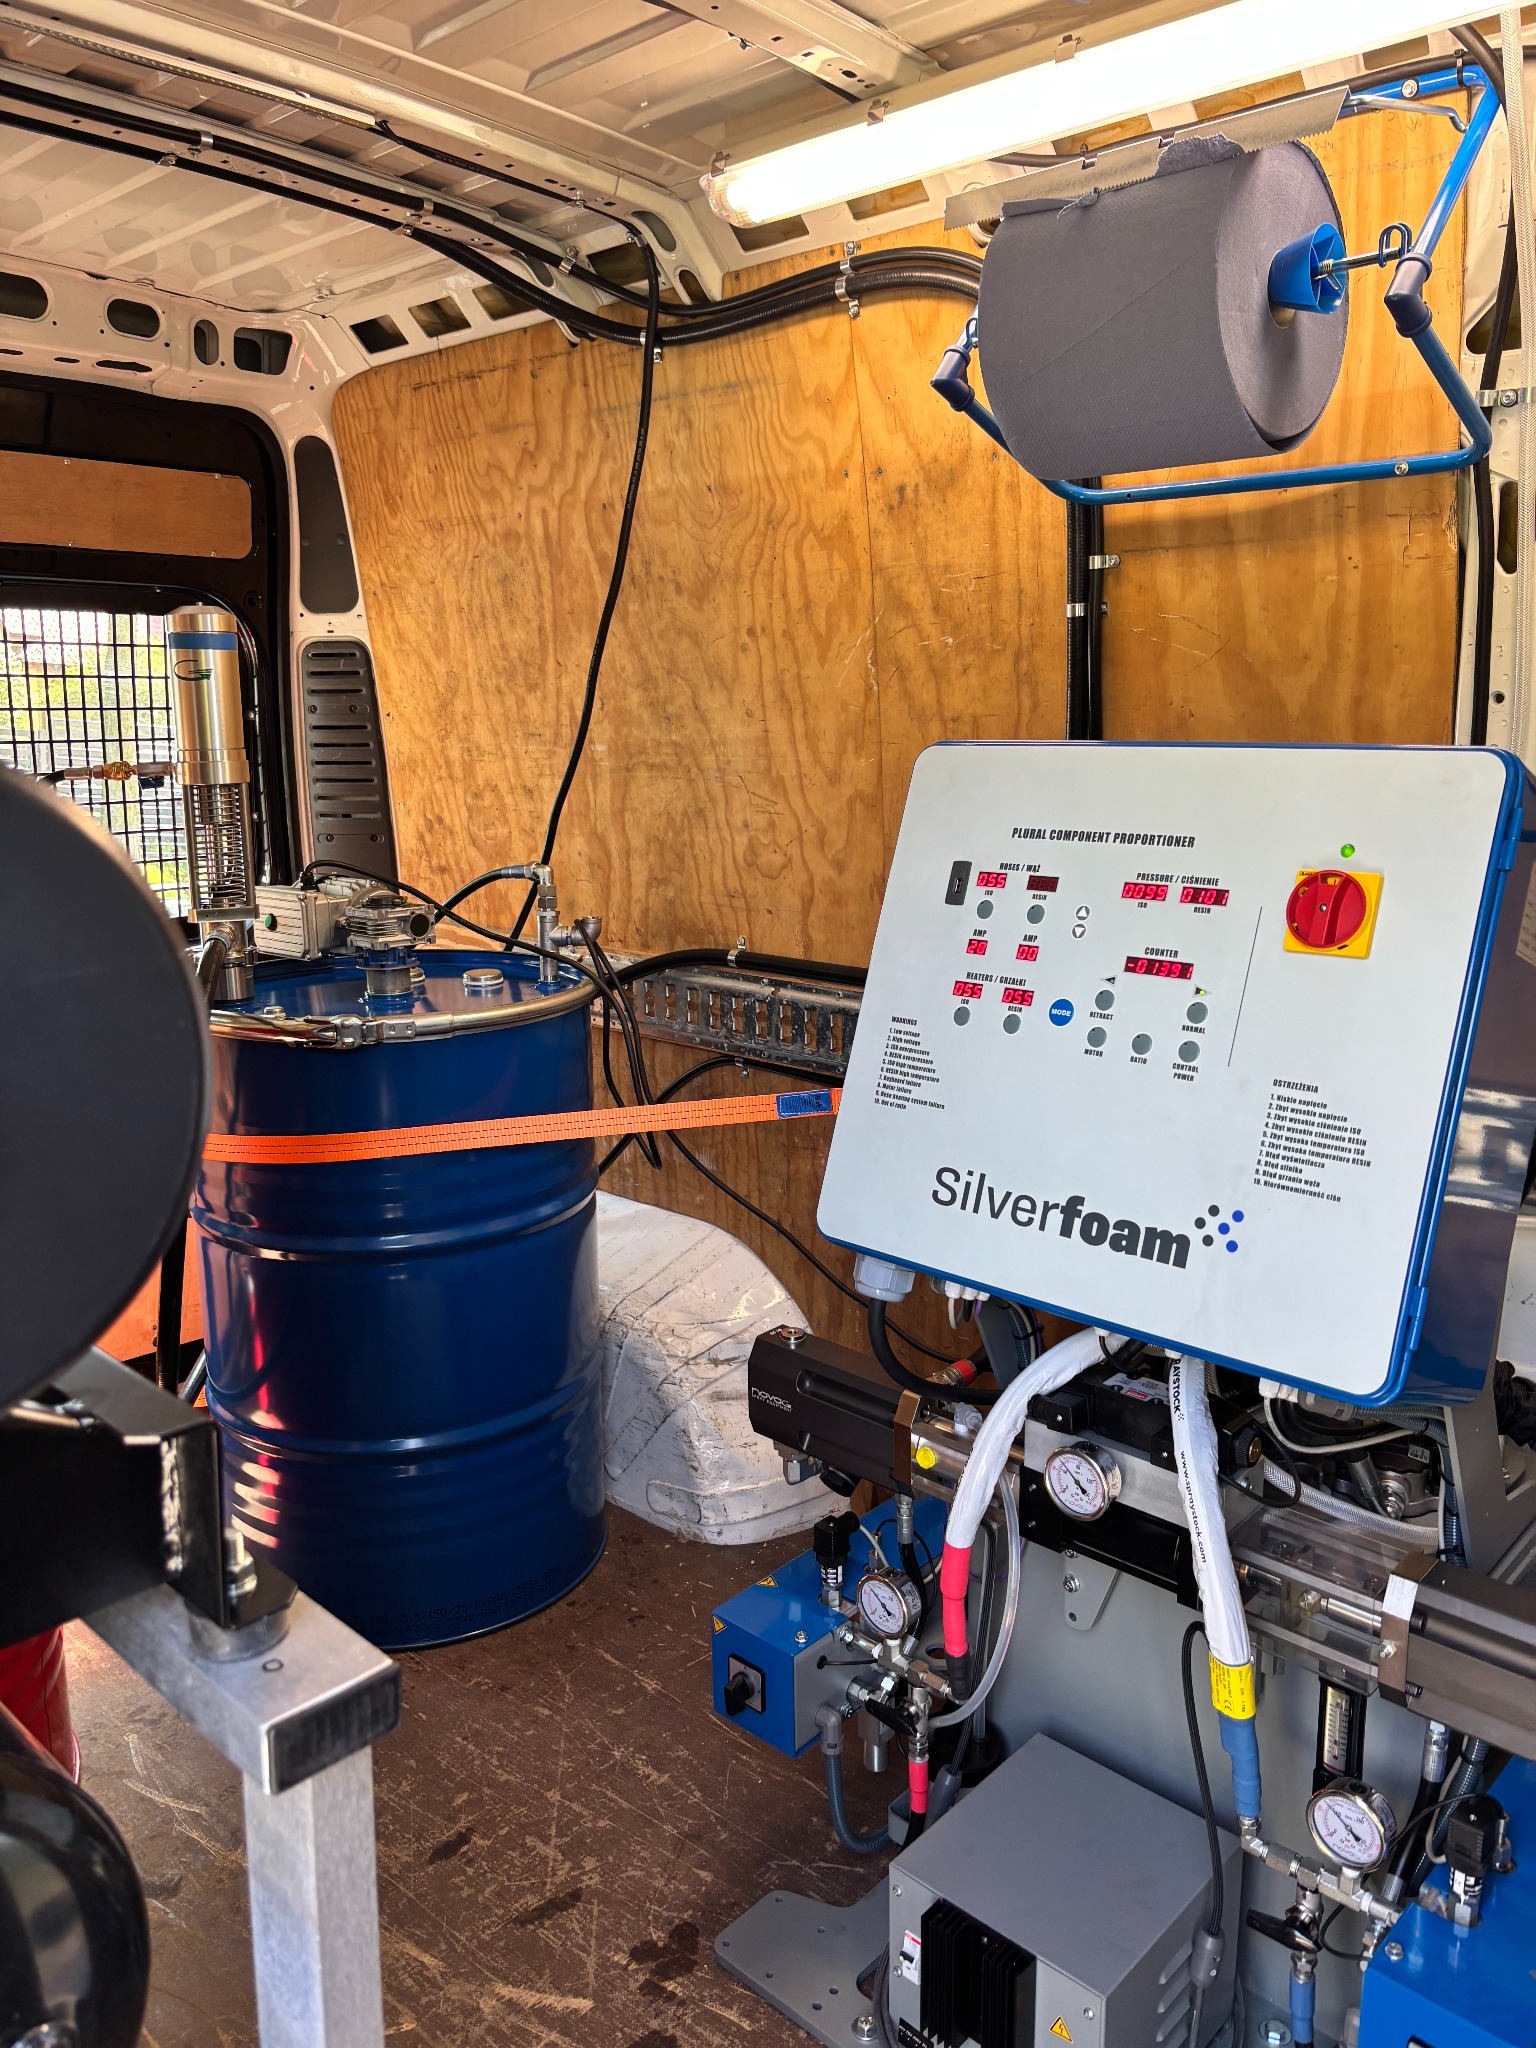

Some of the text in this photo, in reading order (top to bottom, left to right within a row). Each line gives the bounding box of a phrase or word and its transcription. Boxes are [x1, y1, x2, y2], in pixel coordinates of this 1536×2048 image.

[1012, 828, 1195, 848] PLURAL COMPONENT PROPORTIONER
[999, 863, 1020, 871] HOSES
[977, 873, 1006, 888] 055
[1136, 873, 1174, 883] PRESSURE
[1181, 875, 1219, 886] CIŚNIENIE
[1122, 884, 1168, 900] 0099
[1181, 888, 1229, 905] 0101
[973, 929, 987, 937] AMP
[1144, 947, 1178, 958] COUNTER
[966, 972, 993, 982] HEATERS
[1000, 976, 1026, 986] GRZAŁKI
[953, 982, 983, 998] 055
[1002, 989, 1034, 1005] 055
[1051, 1008, 1071, 1016] MODE
[1090, 1012, 1113, 1020] RETRACT
[892, 1016, 917, 1026] WARNINGS
[1182, 1025, 1205, 1034] NORMAL
[1084, 1048, 1103, 1057] MOTOR
[1130, 1056, 1147, 1064] RATIO
[1172, 1063, 1198, 1073] CONTROL
[1173, 1073, 1194, 1081] POWER
[1273, 1079, 1319, 1093] OSTRZEŻENIA
[1277, 1095, 1296, 1104] Niskie
[1275, 1104, 1289, 1112] Zbyt
[1290, 1107, 1317, 1117] wysokie
[1274, 1114, 1287, 1122] Zbyt
[1289, 1117, 1315, 1127] wysokie
[1350, 1127, 1361, 1136] ISO
[1271, 1123, 1285, 1132] Zbyt
[1287, 1126, 1313, 1136] wysokie
[1347, 1136, 1367, 1146] RESIN
[1270, 1132, 1283, 1141] Zbyt
[1285, 1136, 1308, 1146] wysoka
[1310, 1140, 1352, 1153] temperatura
[1354, 1148, 1365, 1156] ISO
[1268, 1142, 1281, 1151] Zbyt
[1283, 1146, 1306, 1155] wysoka
[1308, 1150, 1350, 1163] temperatura
[1352, 1157, 1371, 1167] RESIN
[1280, 1164, 1302, 1174] silnika
[1278, 1173, 1302, 1184] grzania
[931, 1166, 1191, 1269] Silverfoam
[1181, 1451, 1206, 1562] www.spraystock.com
